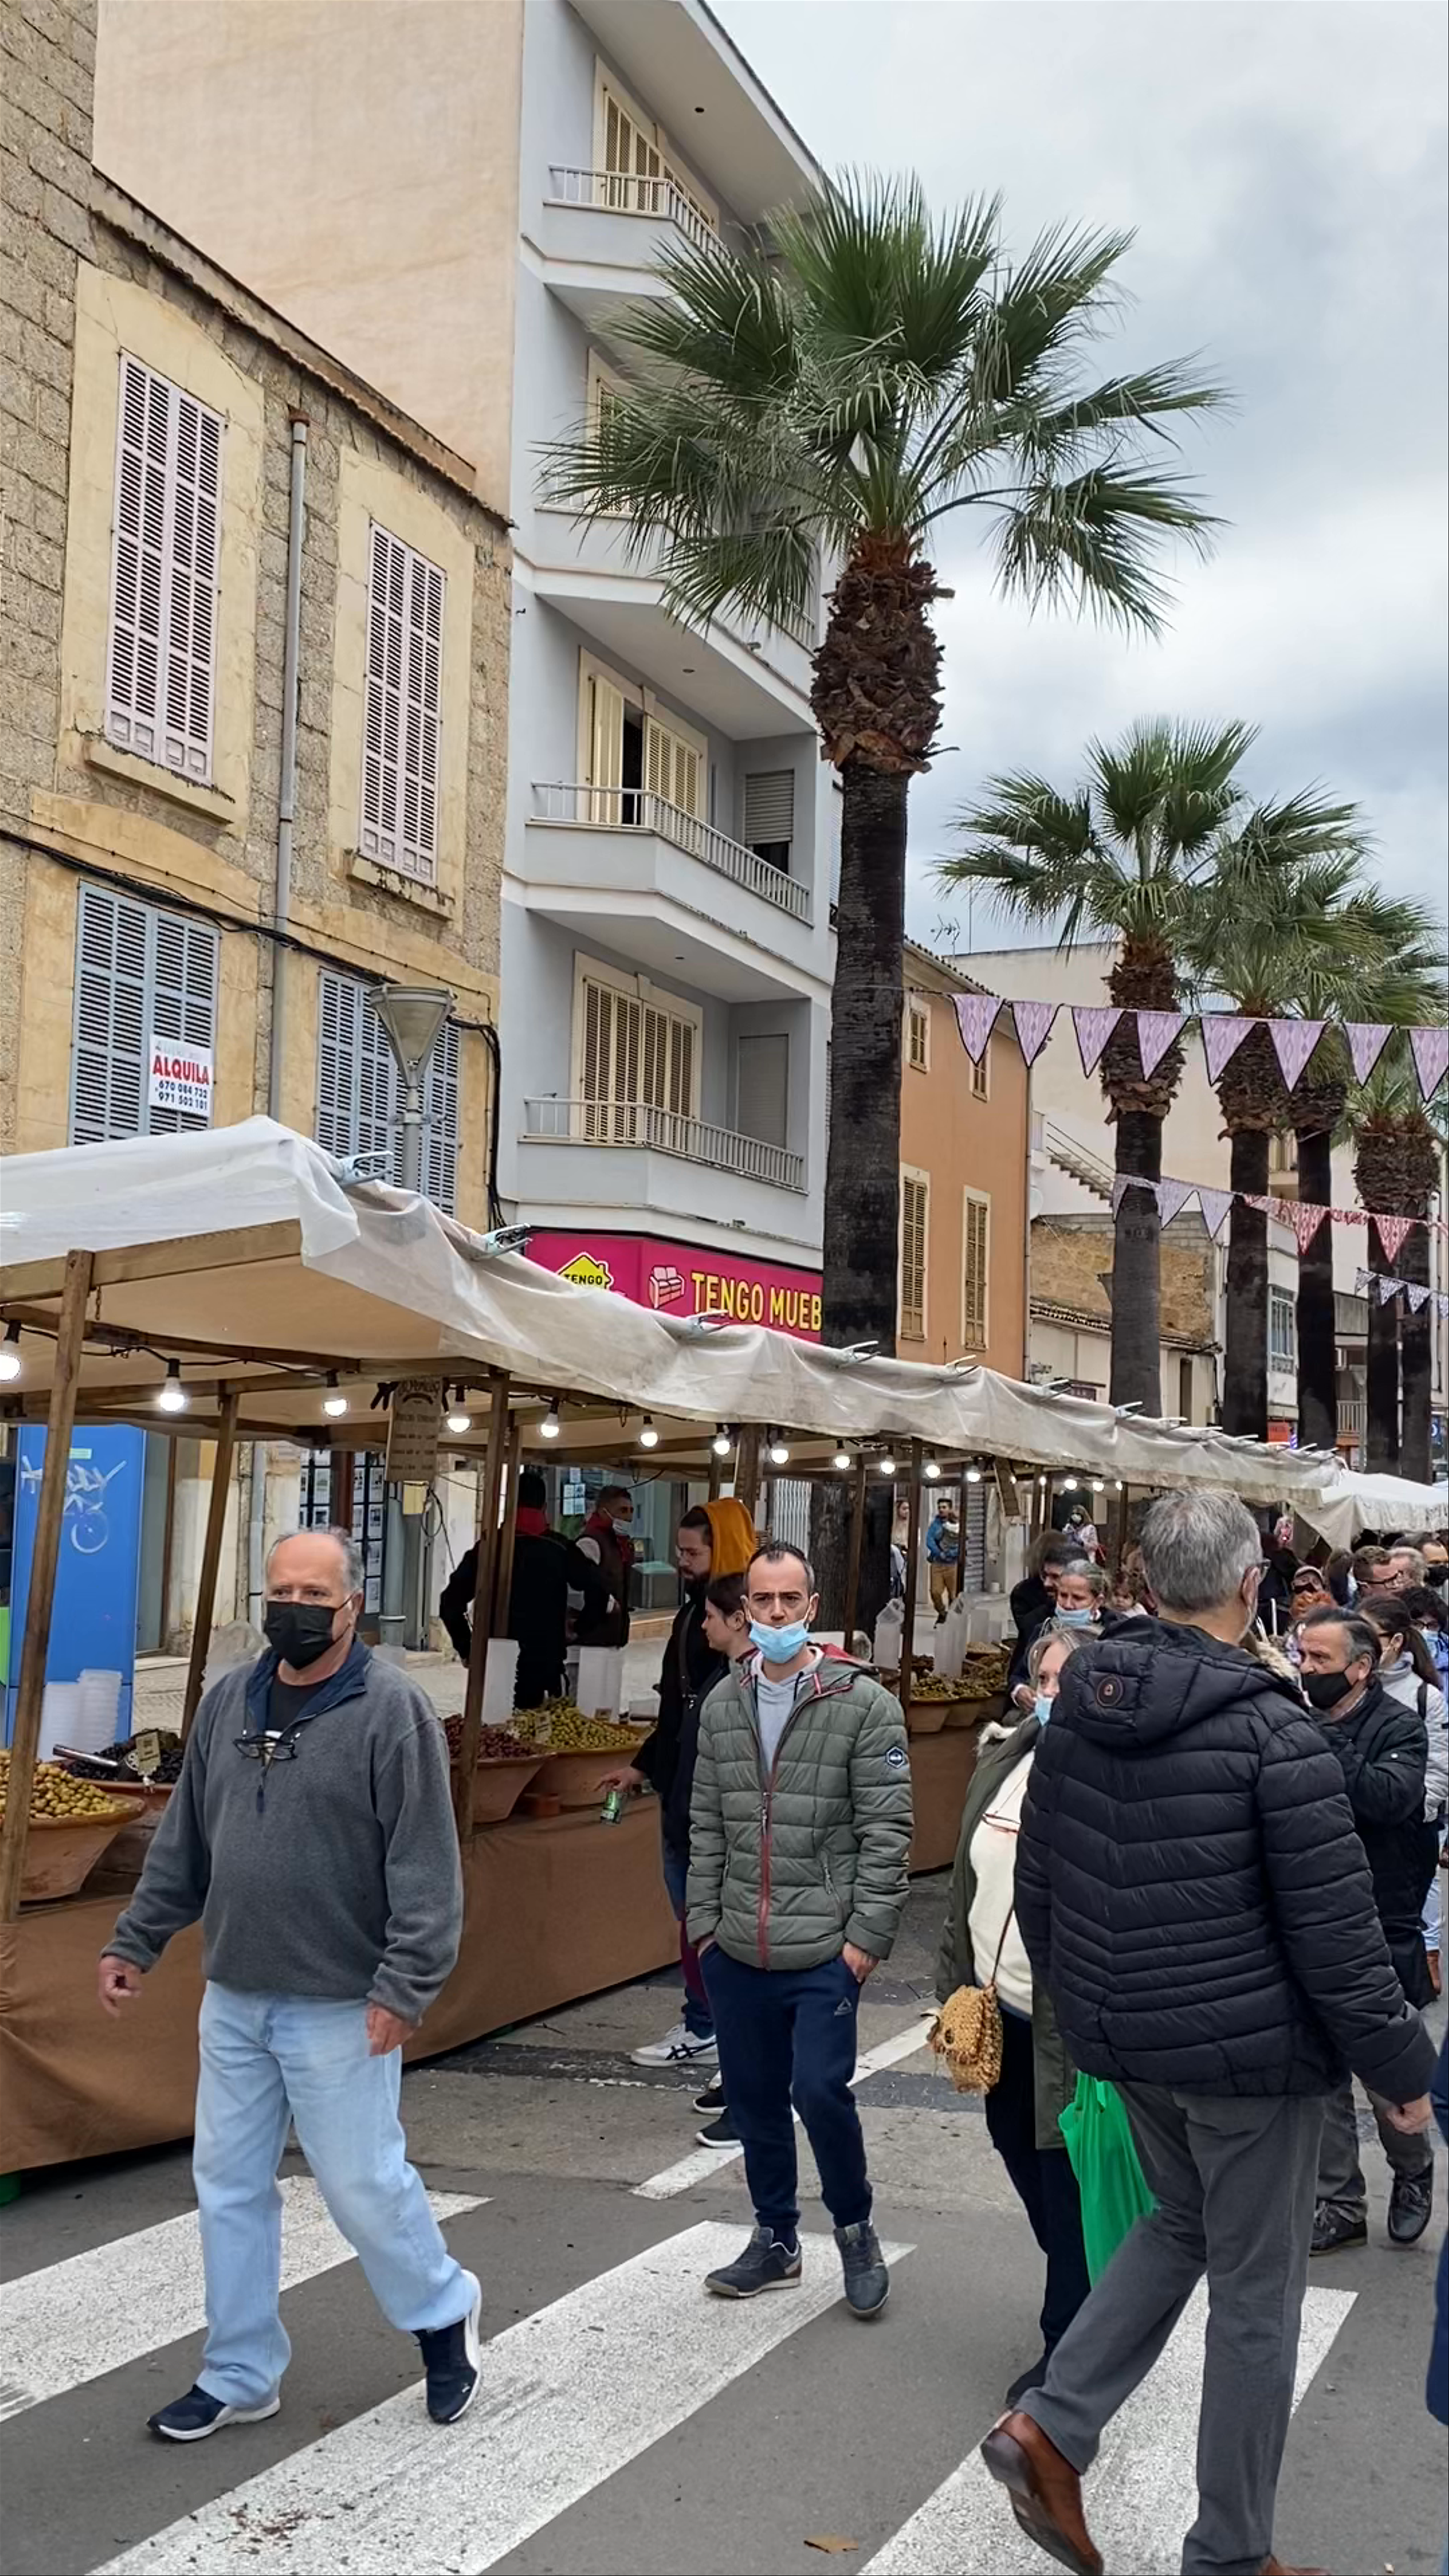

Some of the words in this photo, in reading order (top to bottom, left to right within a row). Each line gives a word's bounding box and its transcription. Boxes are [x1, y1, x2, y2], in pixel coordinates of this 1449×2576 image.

[153, 1055, 209, 1085] ALQUILA
[159, 1080, 175, 1091] 670
[158, 1091, 175, 1103] 971
[178, 1095, 193, 1107] 502
[564, 1274, 602, 1285] TENGO
[691, 1272, 764, 1322] TENGO
